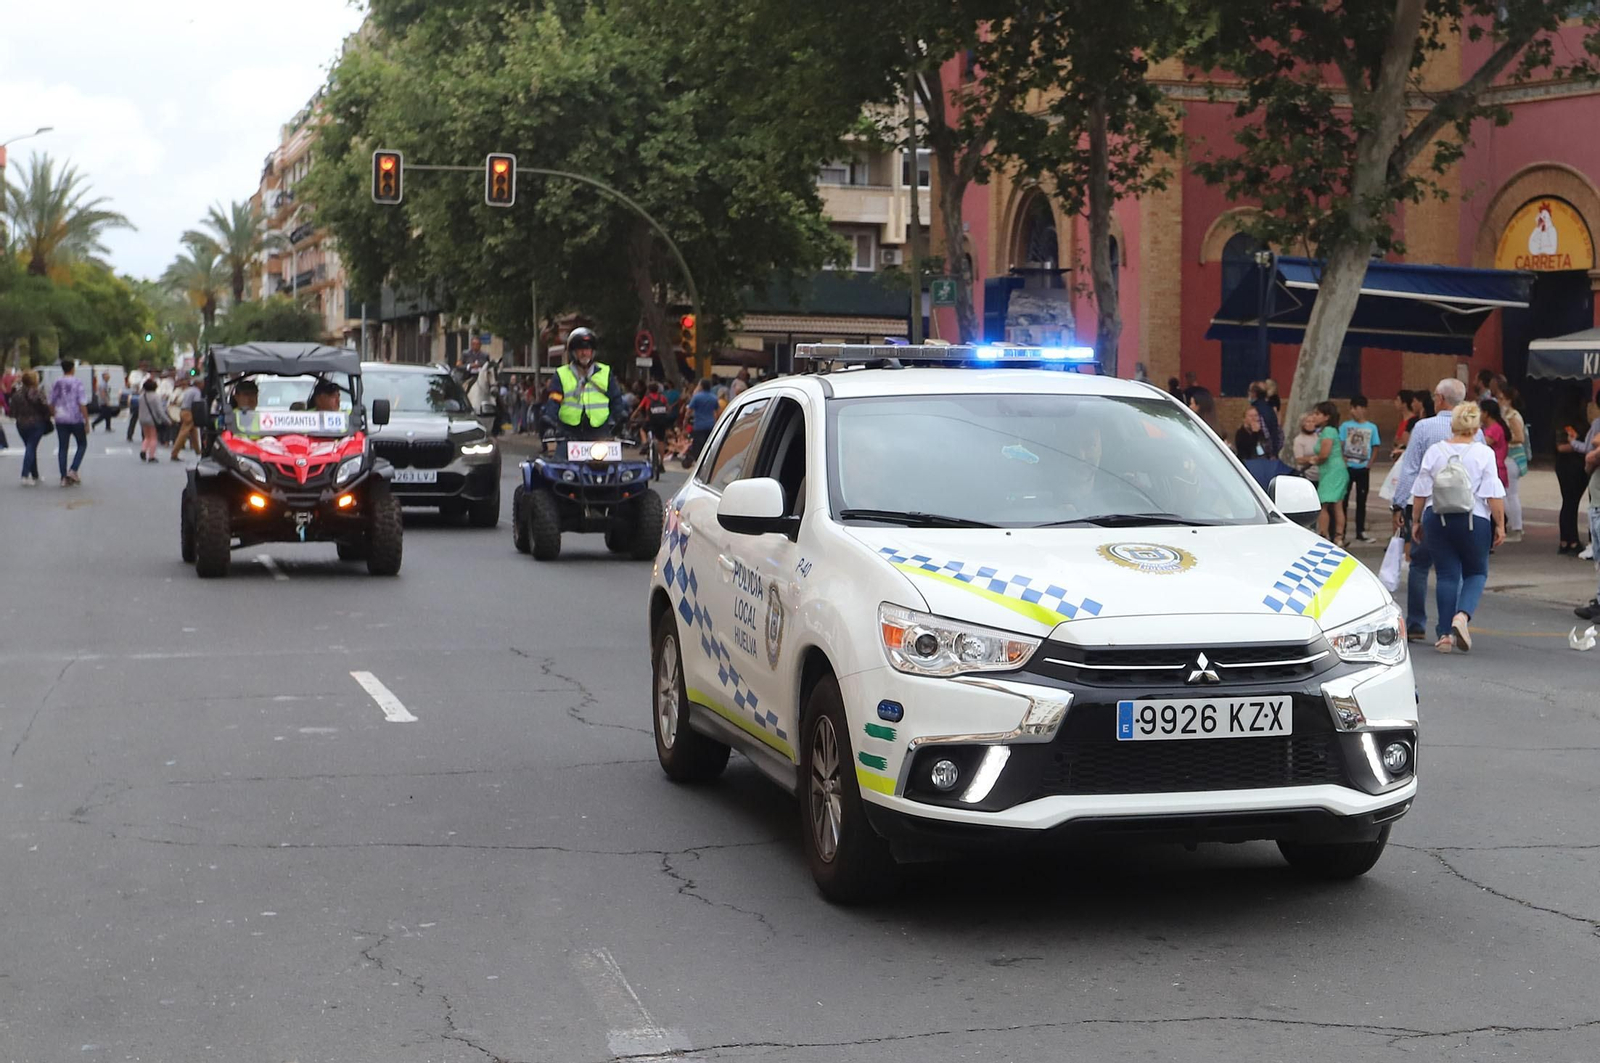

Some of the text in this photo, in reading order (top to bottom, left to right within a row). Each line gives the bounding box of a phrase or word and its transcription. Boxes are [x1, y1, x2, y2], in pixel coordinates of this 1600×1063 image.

[1514, 253, 1573, 270] CARRETA
[274, 415, 317, 427] EMIGRANTES
[327, 416, 342, 427] 58
[580, 445, 619, 457] EMTES
[417, 471, 436, 481] LVJ
[732, 560, 764, 601] POLICÍA
[734, 596, 756, 630] LOCAL
[734, 625, 758, 659] HUELVA
[1139, 704, 1217, 735] 9926
